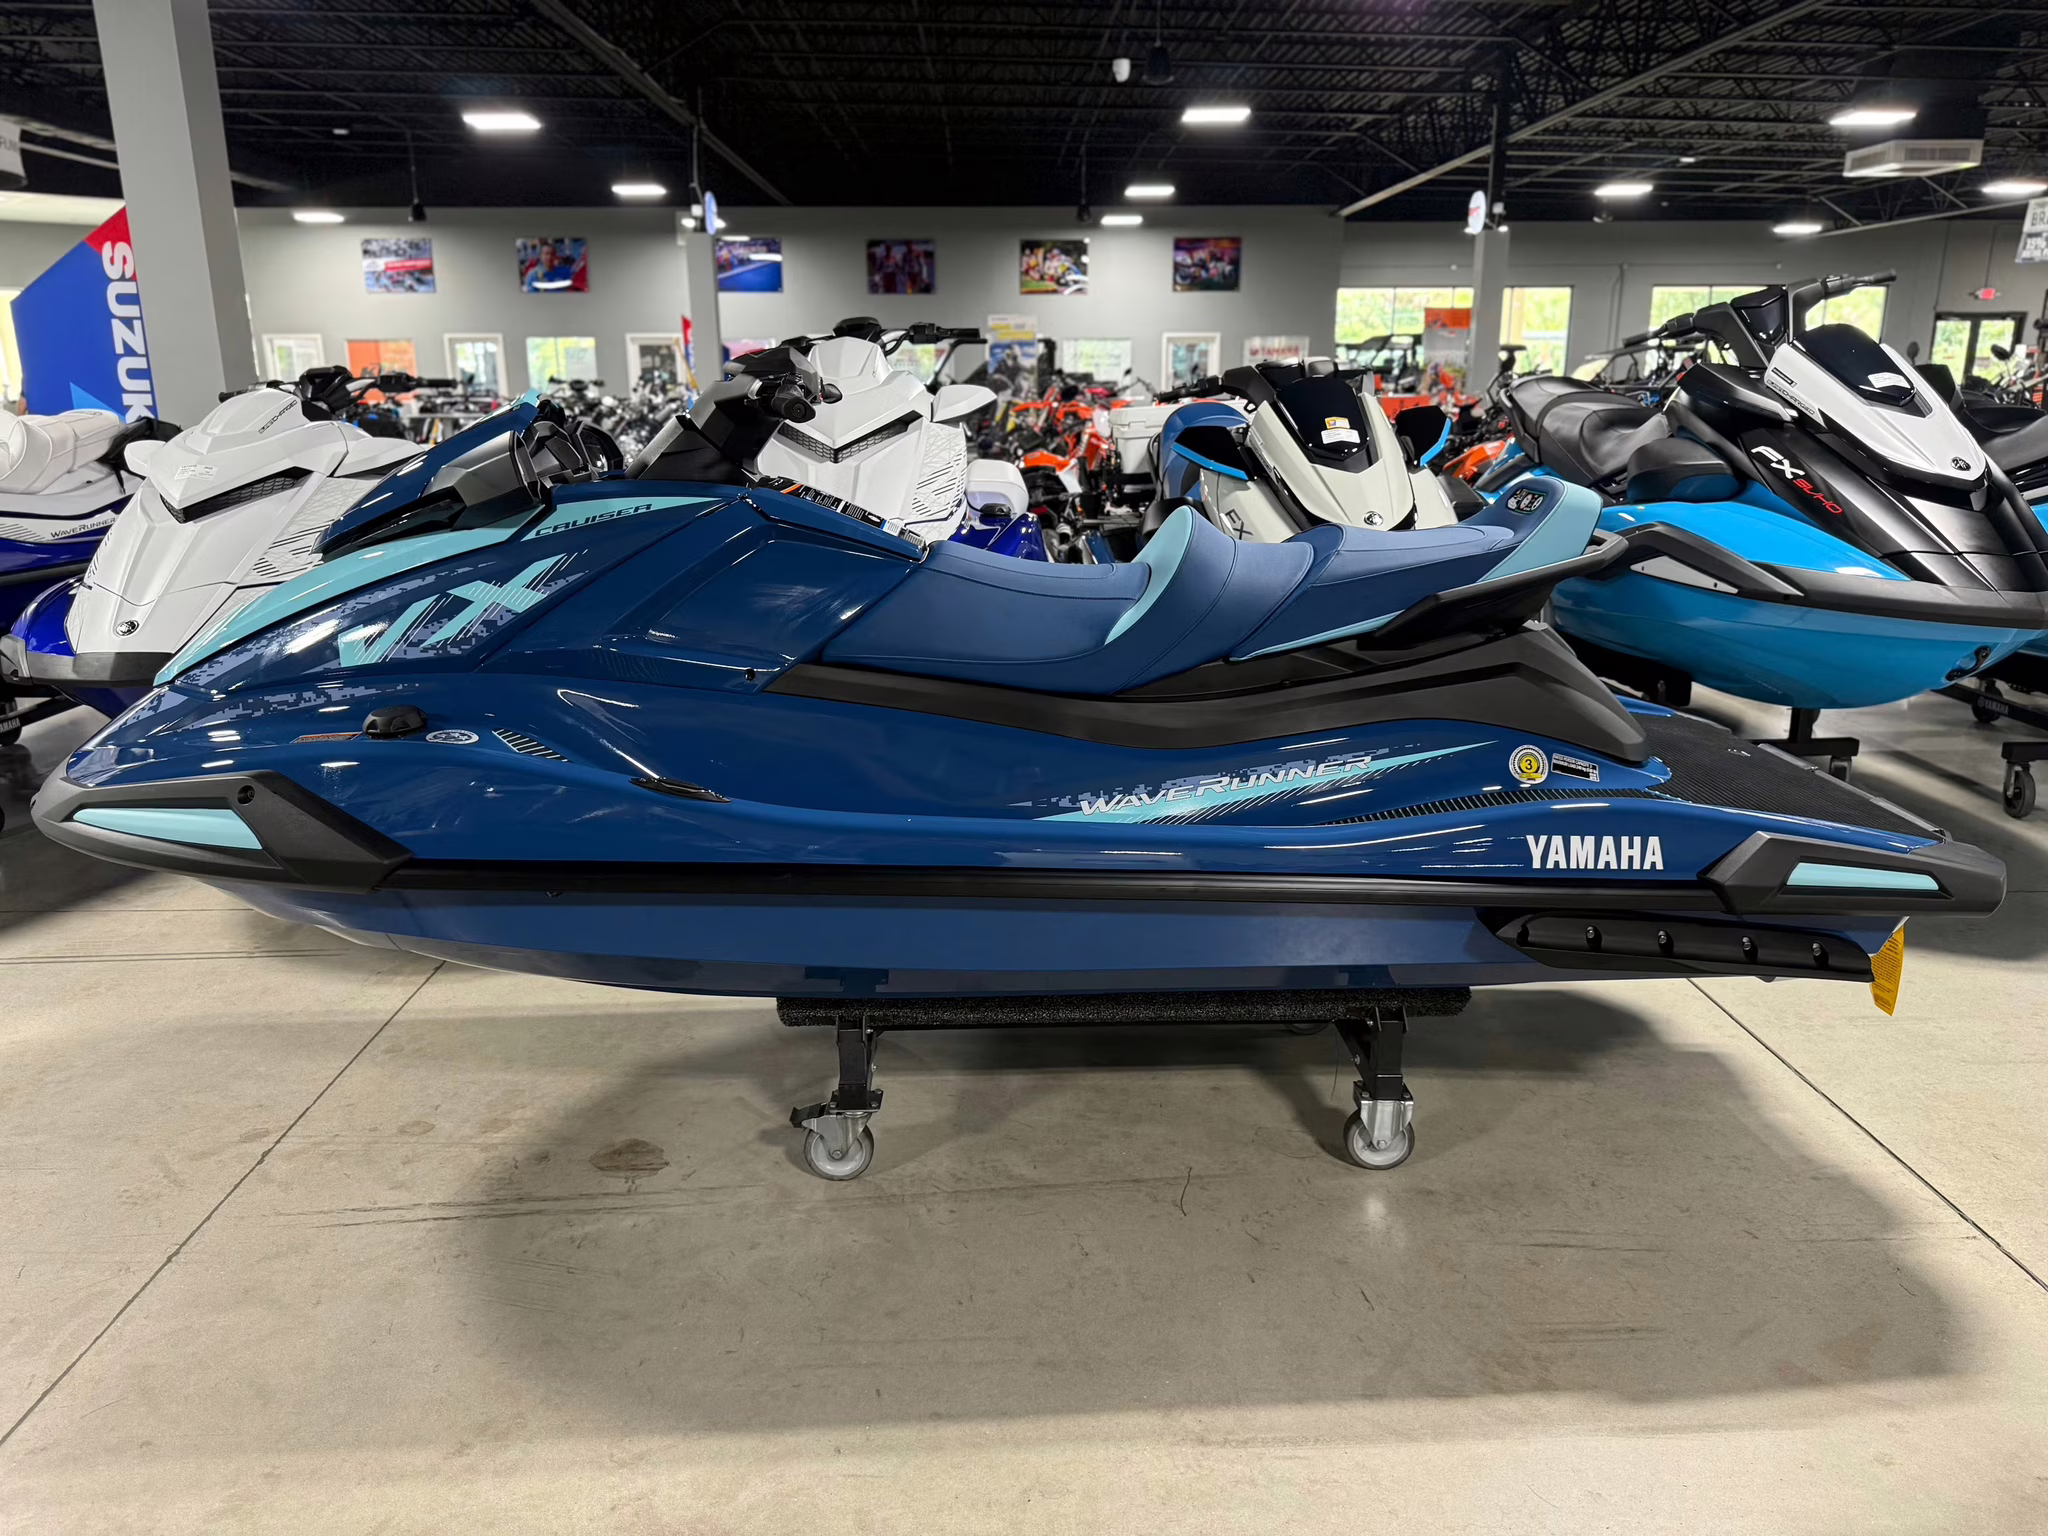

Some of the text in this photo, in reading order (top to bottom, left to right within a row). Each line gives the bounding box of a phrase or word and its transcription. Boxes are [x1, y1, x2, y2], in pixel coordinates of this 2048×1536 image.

[1750, 445, 1844, 515] FX SVHO
[533, 503, 653, 538] CRUISER
[1525, 758, 1533, 771] 3
[1526, 834, 1664, 871] YAMAHA
